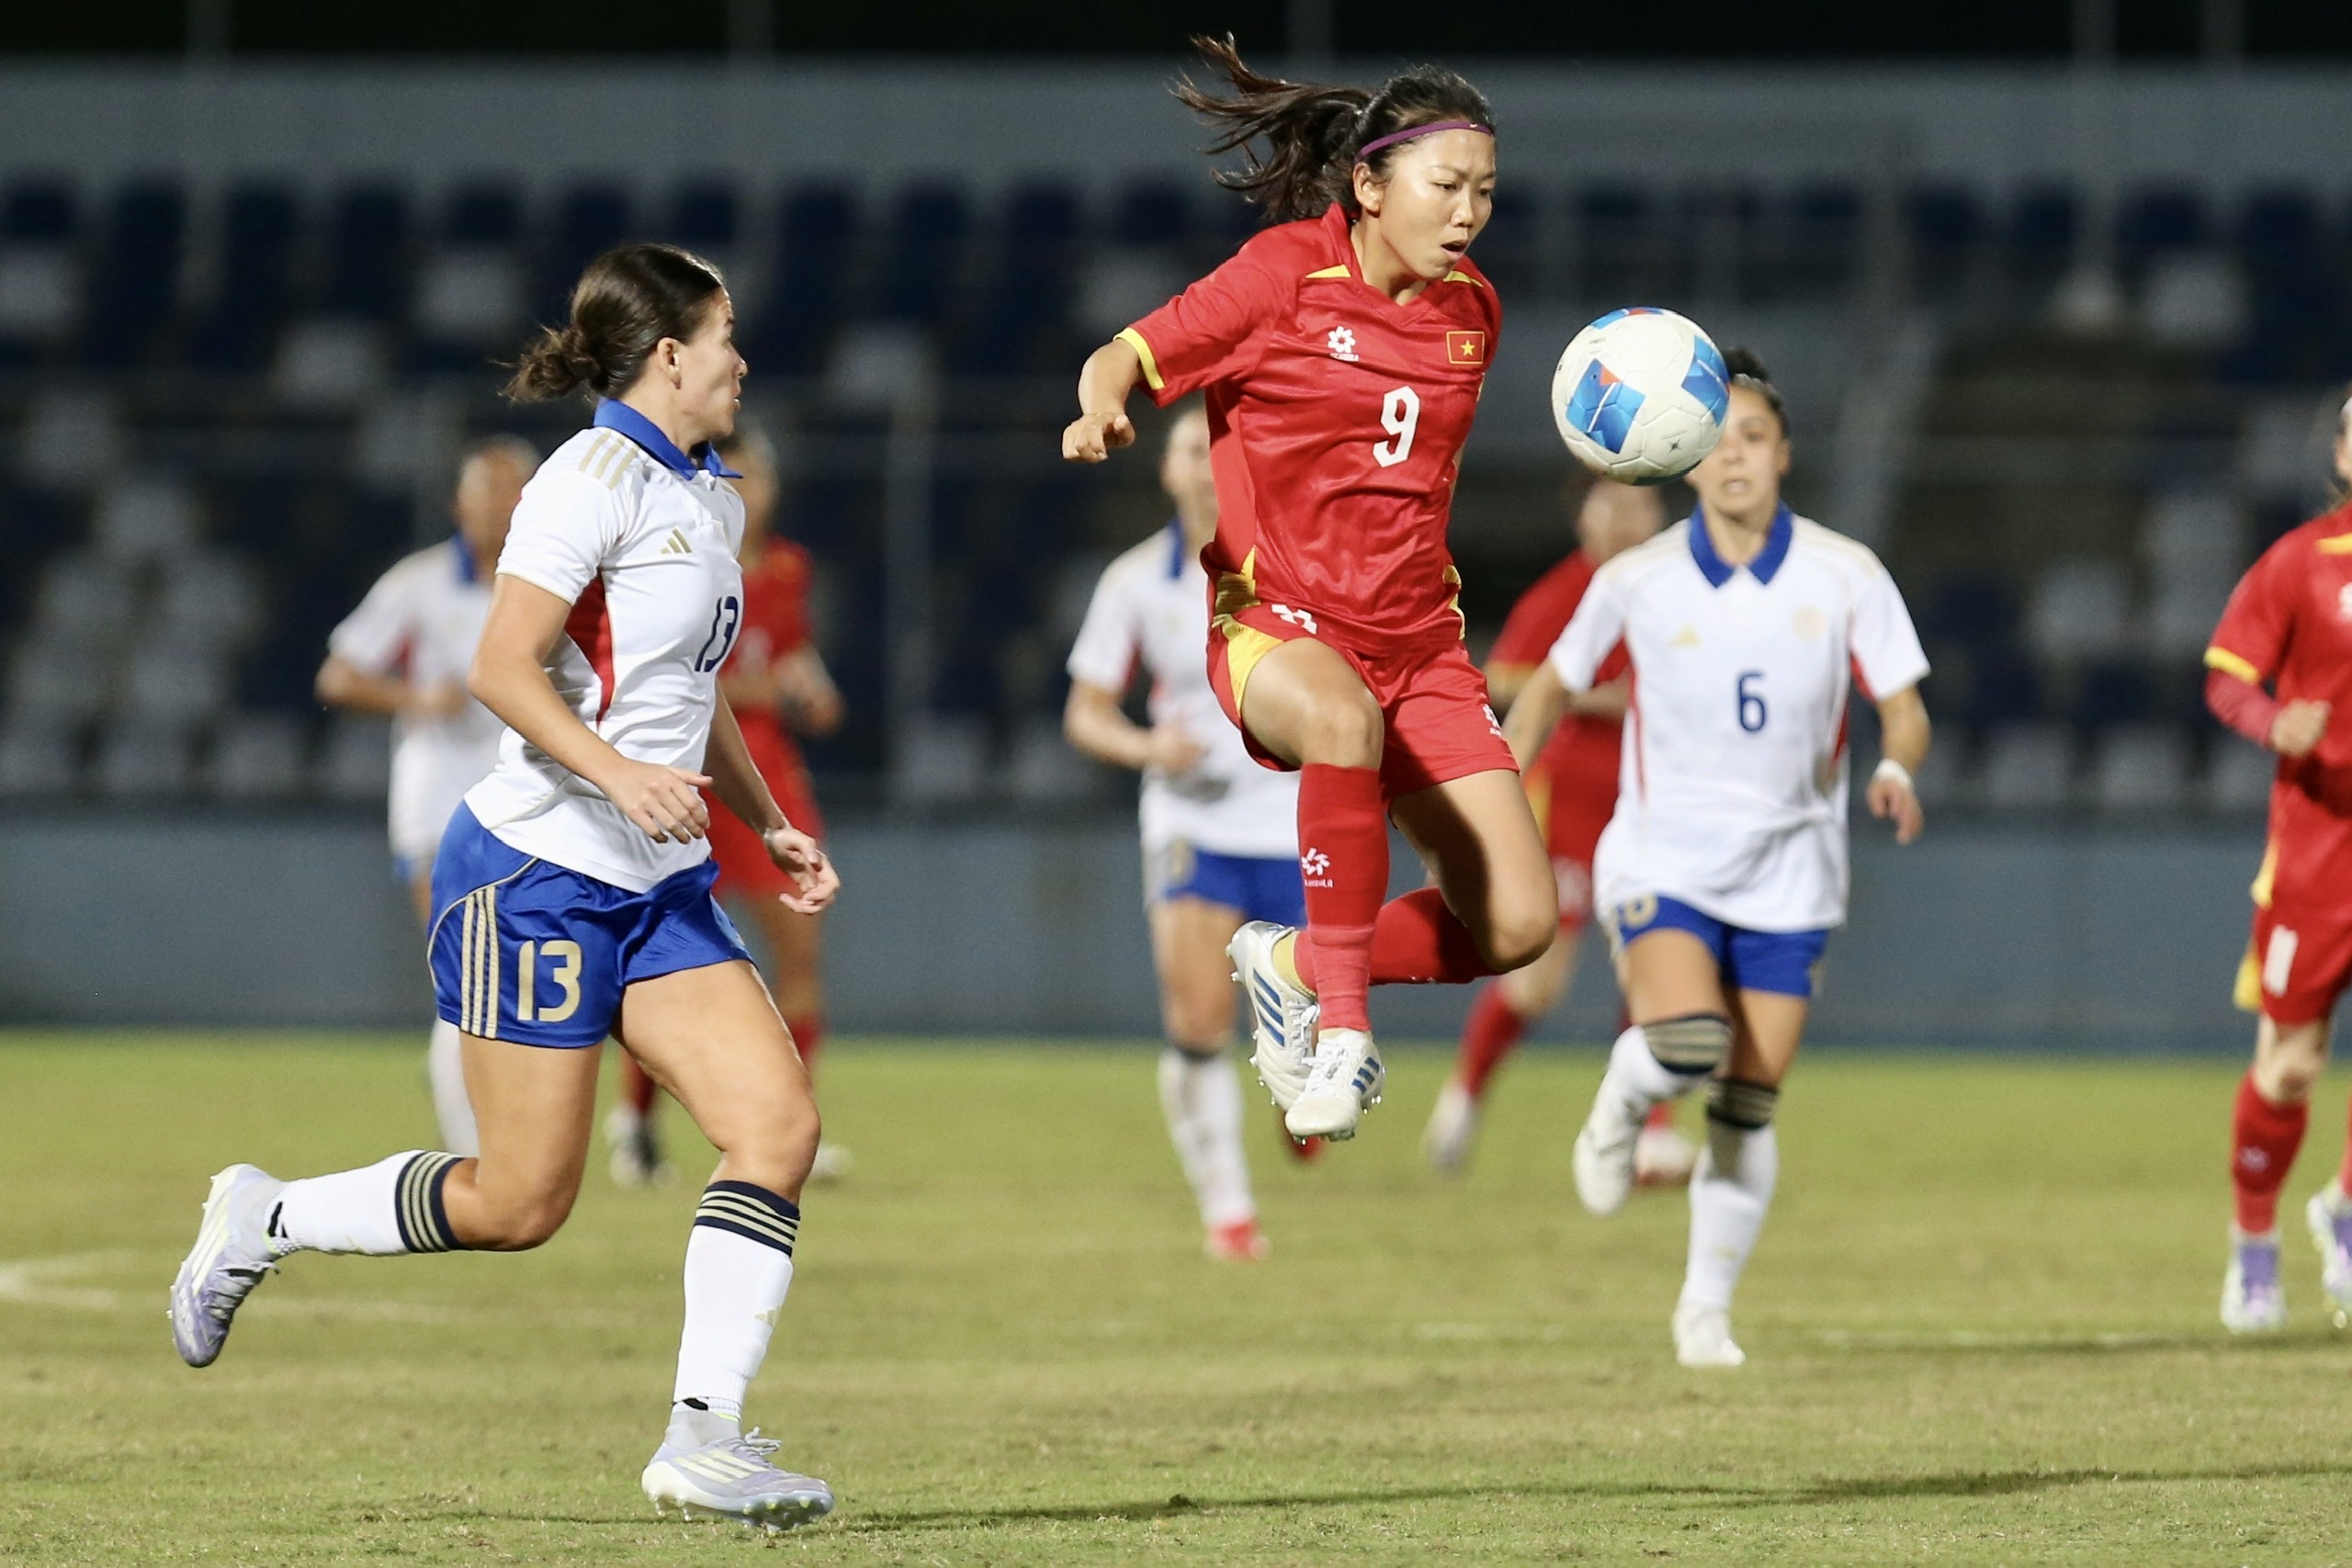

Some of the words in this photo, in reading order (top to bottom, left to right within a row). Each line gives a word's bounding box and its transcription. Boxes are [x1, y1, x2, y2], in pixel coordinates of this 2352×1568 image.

[1373, 386, 1420, 468] 9
[694, 596, 738, 672] 13
[1736, 670, 1766, 733] 6
[517, 940, 582, 1022] 13
